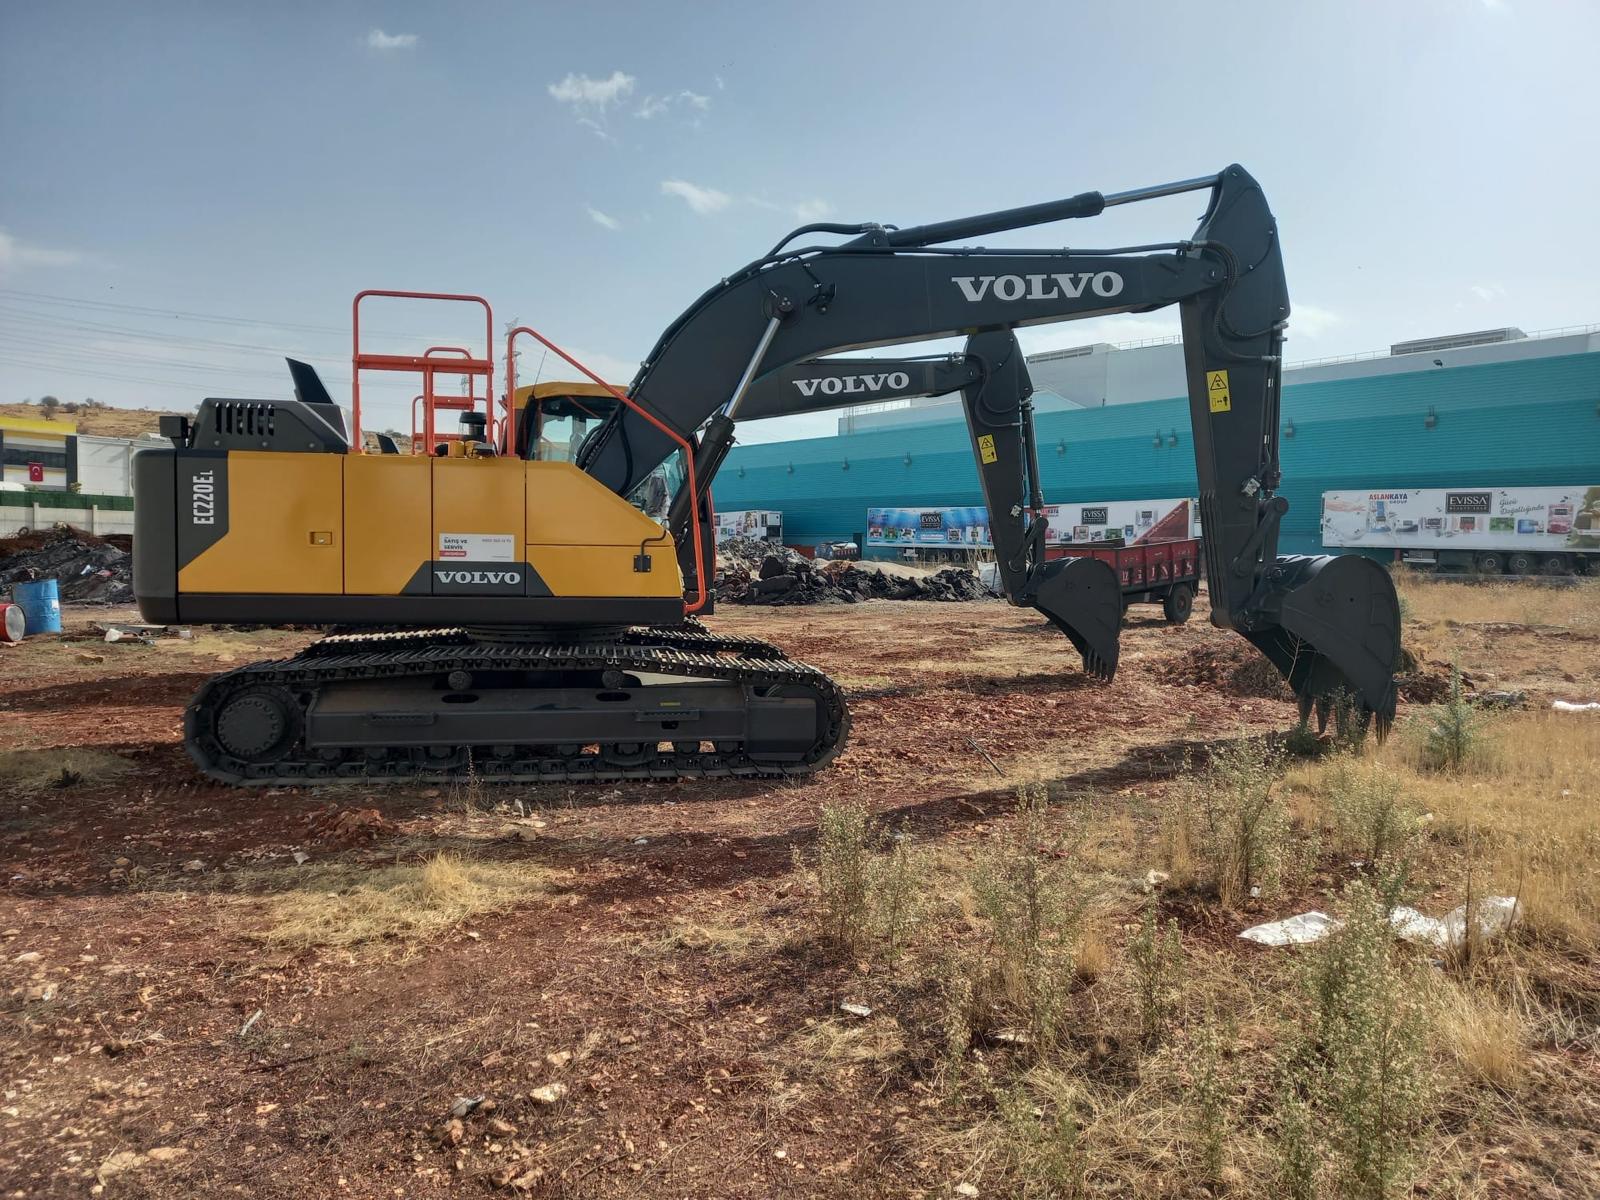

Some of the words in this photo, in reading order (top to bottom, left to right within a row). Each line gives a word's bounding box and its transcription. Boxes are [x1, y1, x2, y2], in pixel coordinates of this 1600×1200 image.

[951, 271, 1124, 302] VOLVO
[791, 371, 910, 396] VOLVO
[1450, 496, 1488, 505] EVISSA
[921, 515, 941, 523] EVISSA
[1083, 510, 1106, 518] EVISSA
[434, 571, 521, 585] VOLVO
